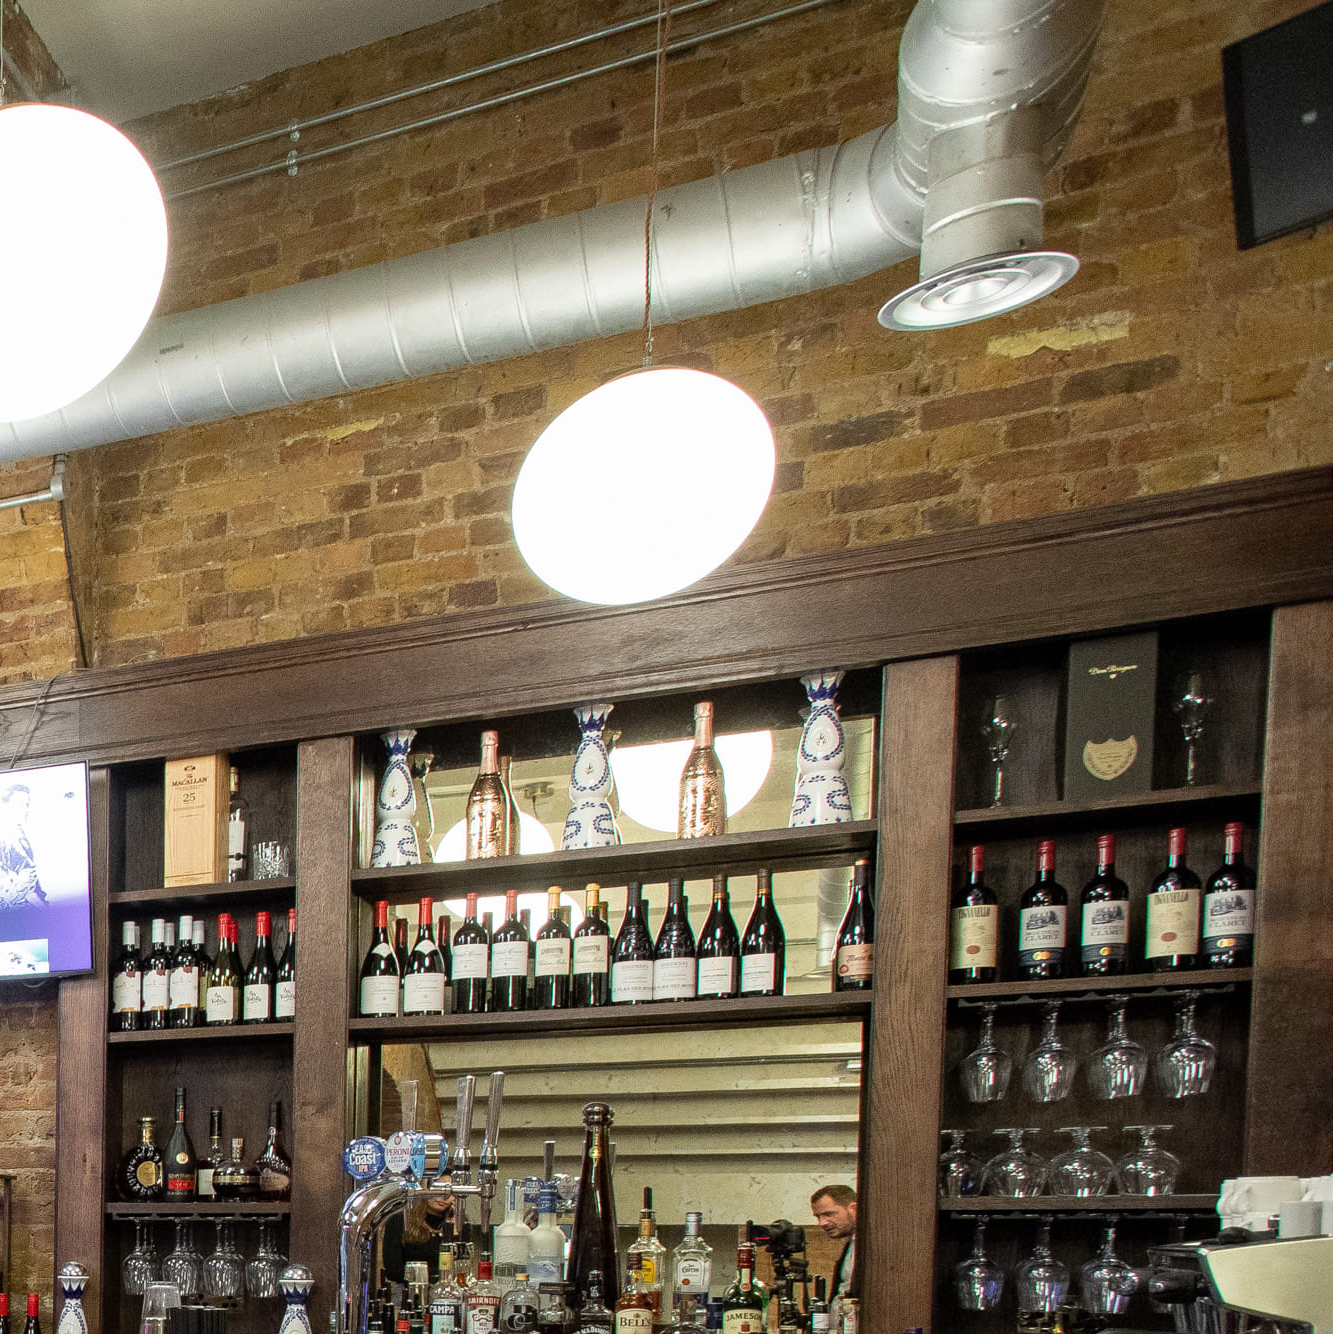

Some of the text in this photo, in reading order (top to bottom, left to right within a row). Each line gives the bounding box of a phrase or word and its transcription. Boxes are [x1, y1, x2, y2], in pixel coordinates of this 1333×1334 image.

[171, 776, 208, 787] MACALLAN
[182, 792, 196, 803] 25
[352, 1144, 374, 1155] EAST
[386, 1148, 410, 1156] PERONI
[349, 1152, 376, 1165] Coast
[619, 1316, 652, 1327] BELL'S
[725, 1311, 762, 1322] JAMESON
